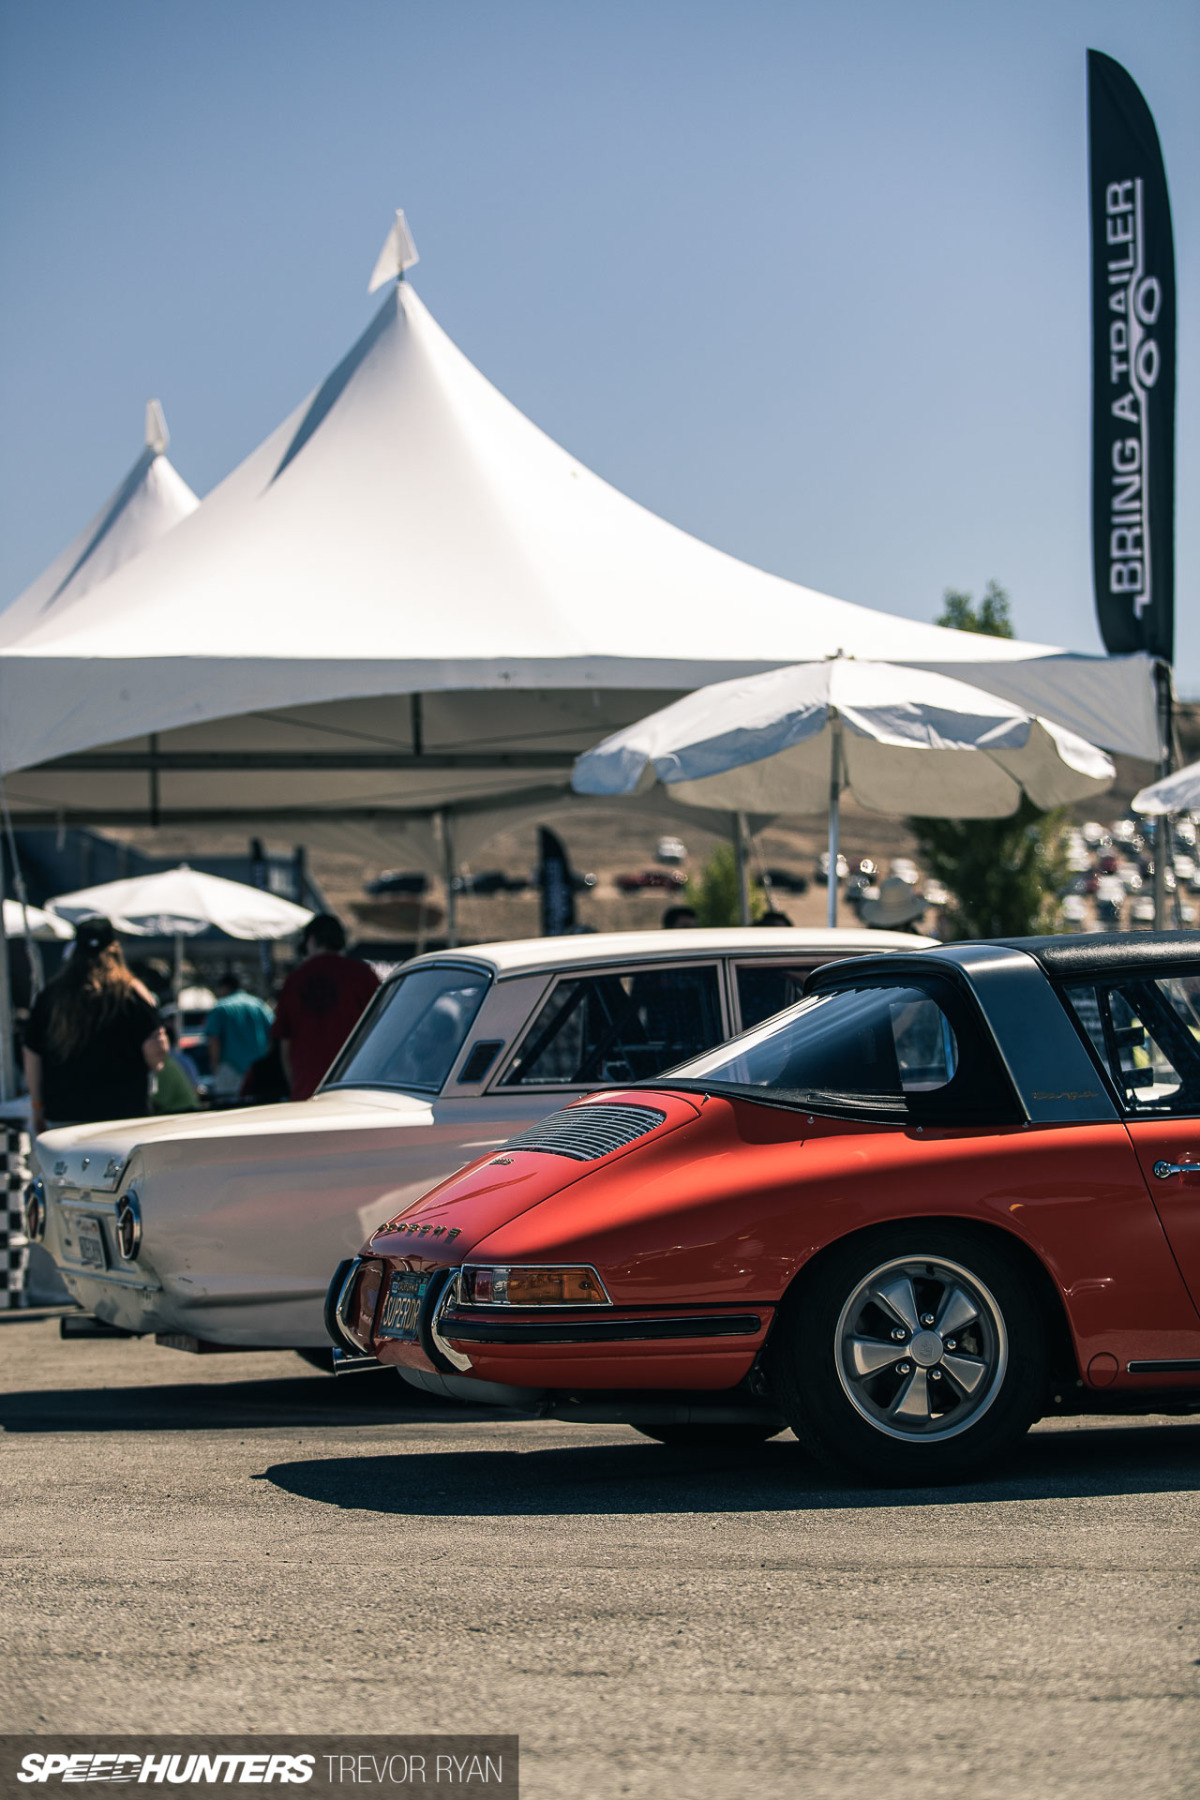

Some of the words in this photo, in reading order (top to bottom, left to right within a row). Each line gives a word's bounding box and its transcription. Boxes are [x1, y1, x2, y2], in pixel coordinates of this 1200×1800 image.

[1105, 178, 1137, 384] TRAILER
[1111, 392, 1140, 423] A
[1110, 437, 1144, 594] BRING
